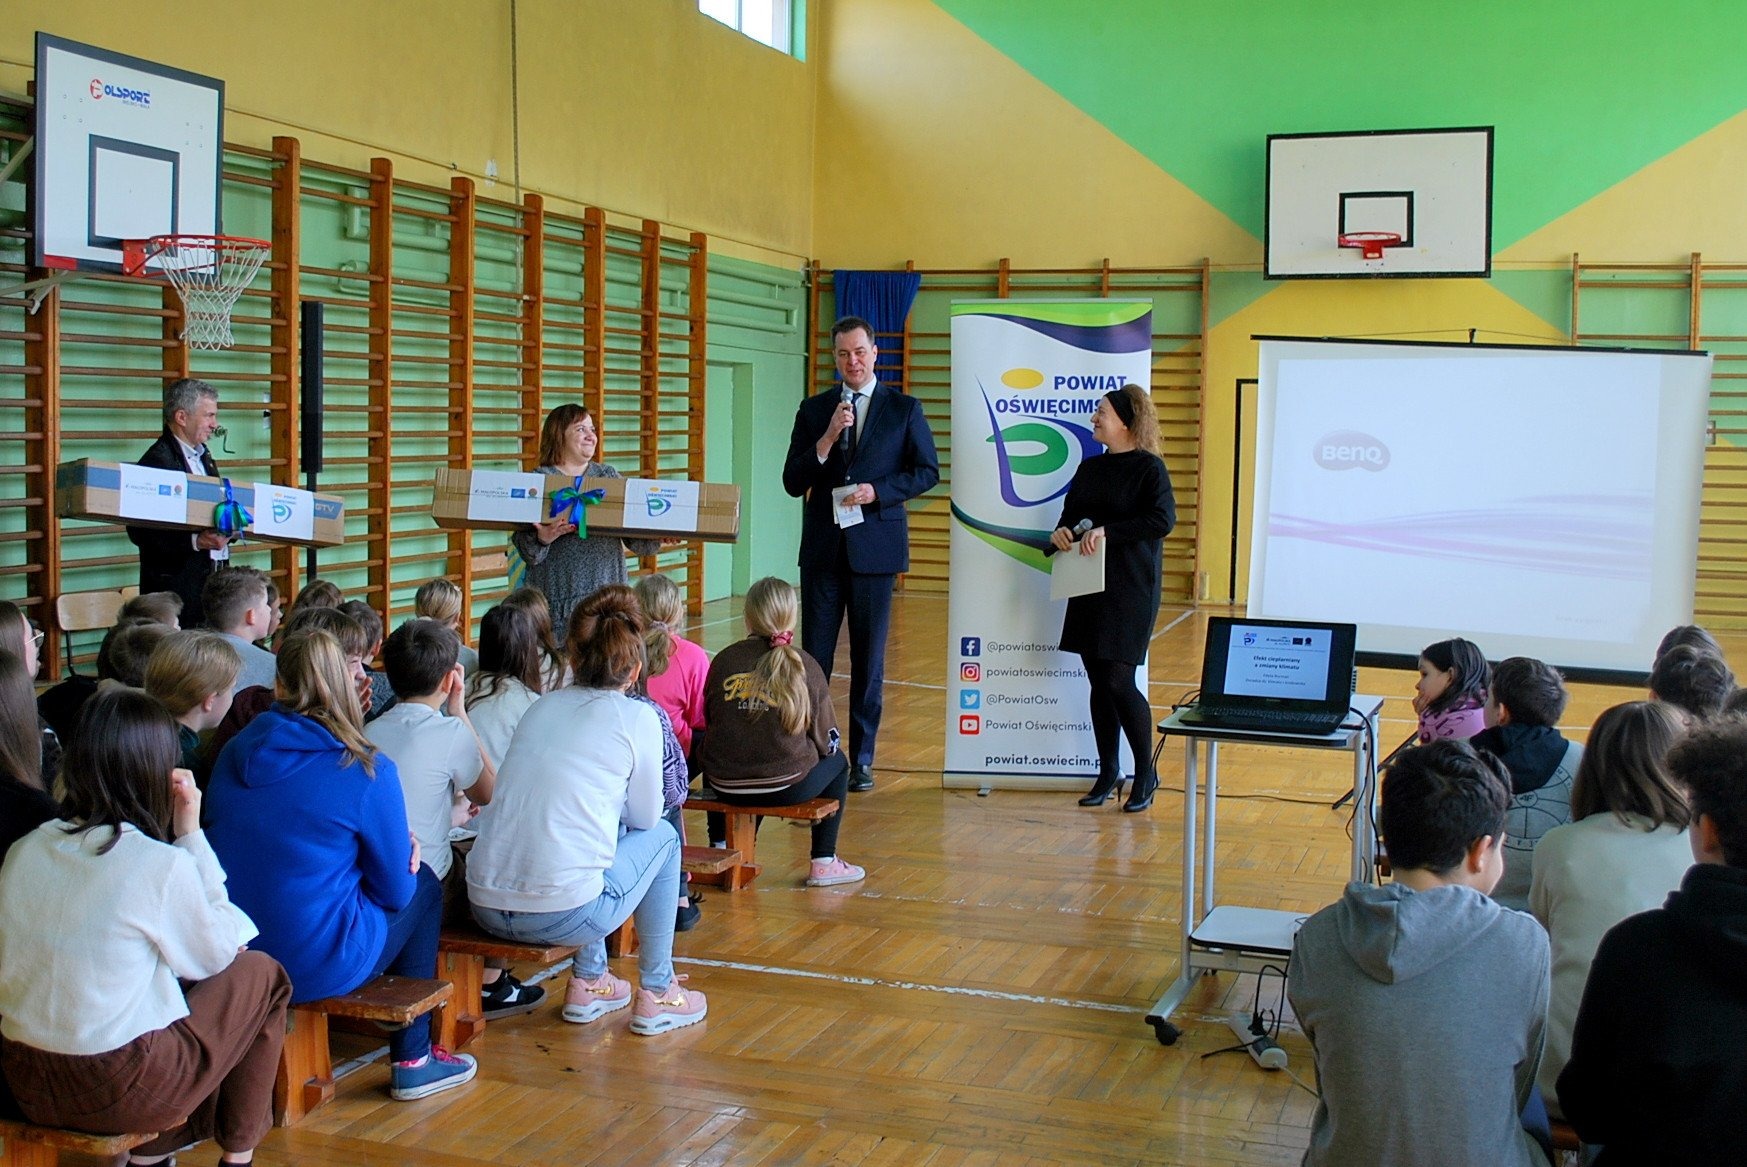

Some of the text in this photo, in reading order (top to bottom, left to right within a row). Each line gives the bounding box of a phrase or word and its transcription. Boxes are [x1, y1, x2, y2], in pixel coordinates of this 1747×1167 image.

[1054, 375, 1127, 390] POWIAT
[986, 667, 1086, 679] powiatoswiecimski
[986, 693, 1059, 706] @PowiatOsw
[985, 719, 1092, 733] Powiat Oświęcimski
